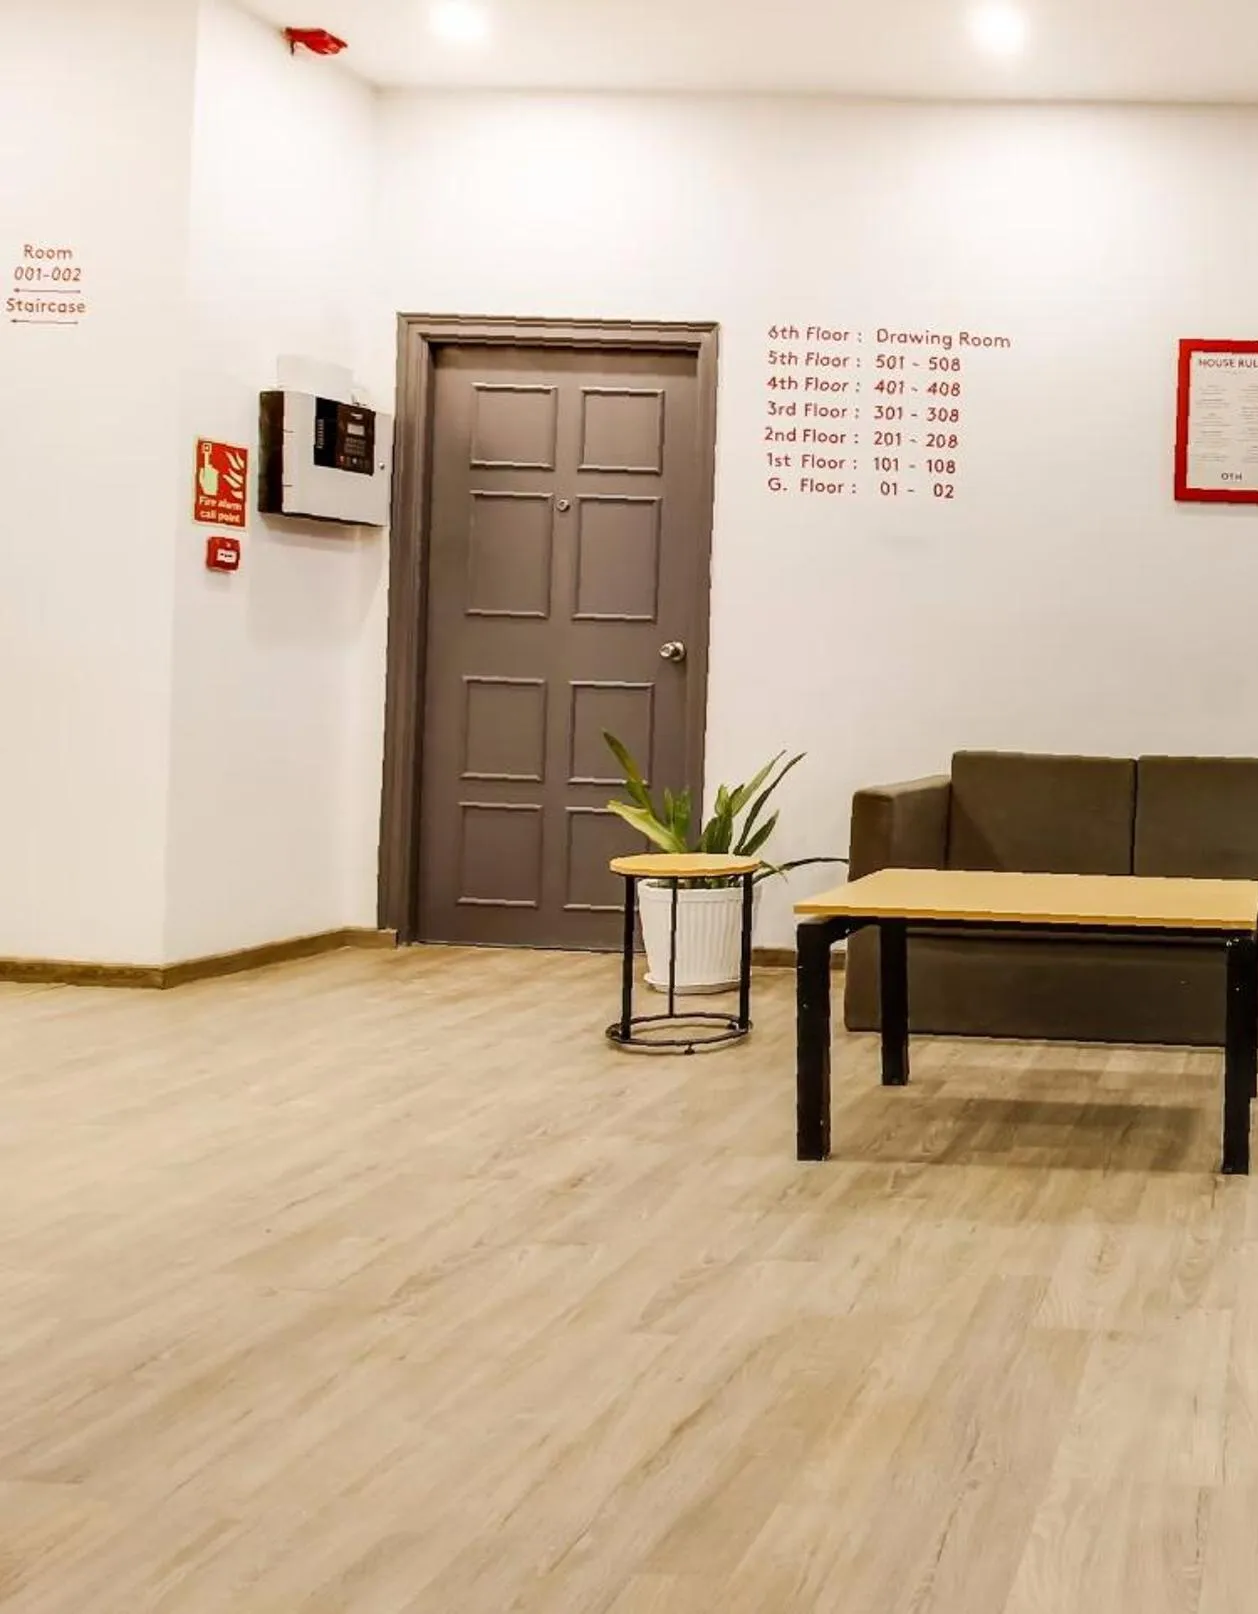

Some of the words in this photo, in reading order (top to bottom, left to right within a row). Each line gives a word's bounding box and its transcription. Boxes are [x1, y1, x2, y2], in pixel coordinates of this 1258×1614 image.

[24, 244, 73, 260] Room
[14, 266, 81, 282] 001-002
[6, 298, 86, 313] Staircase
[768, 325, 799, 340] 6th
[806, 326, 850, 341] Floor
[877, 328, 952, 350] Drawing
[959, 331, 1011, 348] Room
[768, 350, 798, 366] 5th
[805, 352, 849, 368] Floor
[875, 354, 904, 370] 501
[928, 356, 961, 372] 508
[1199, 358, 1236, 368] HOUSE
[767, 376, 798, 390] 4th
[804, 377, 849, 392] Floor
[874, 379, 904, 395] 401
[926, 381, 961, 397] 408
[767, 400, 796, 416] 3rd
[804, 403, 847, 418] Floor
[874, 405, 902, 420] 301
[926, 407, 959, 423] 308
[764, 427, 796, 442] 2nd
[803, 428, 847, 444] Floor
[873, 431, 901, 446] 201
[926, 433, 958, 448] 208
[766, 452, 791, 467] 1st
[801, 454, 846, 469] Floor
[873, 457, 899, 472] 101
[926, 459, 956, 474] 108
[767, 477, 788, 491] G.
[800, 478, 844, 494] Floor
[880, 481, 898, 496] 01
[933, 483, 955, 499] 02
